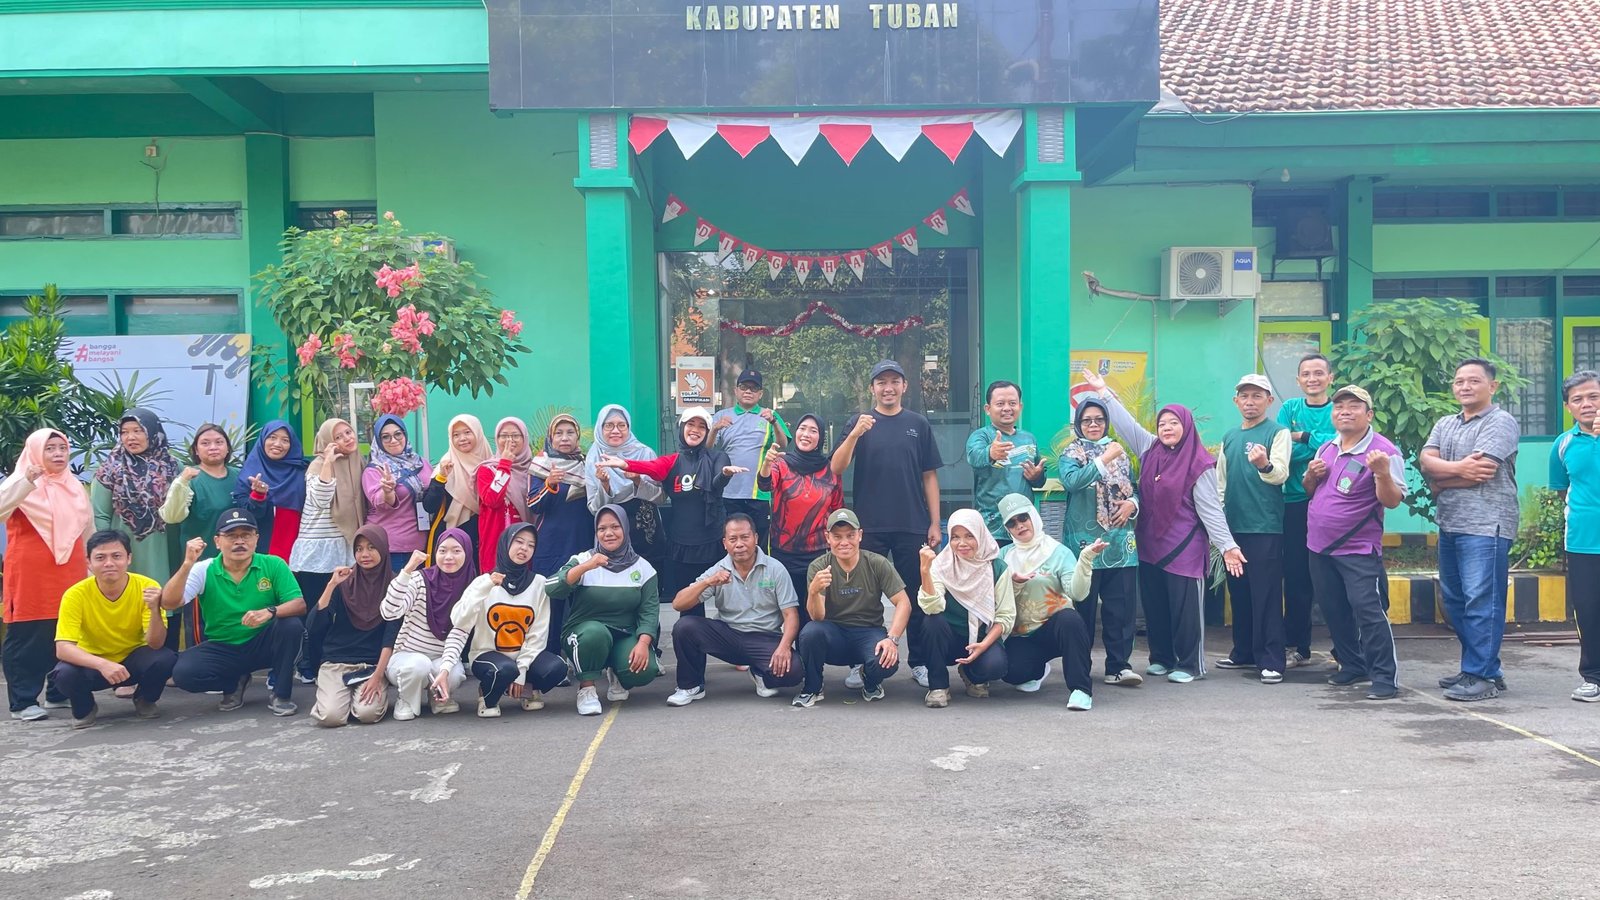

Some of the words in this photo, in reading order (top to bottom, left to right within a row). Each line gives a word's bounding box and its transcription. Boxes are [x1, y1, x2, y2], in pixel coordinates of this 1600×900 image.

[686, 4, 840, 31] KABUPATEN
[869, 3, 958, 29] TUBAN
[698, 225, 915, 274] DIRGAHAYU
